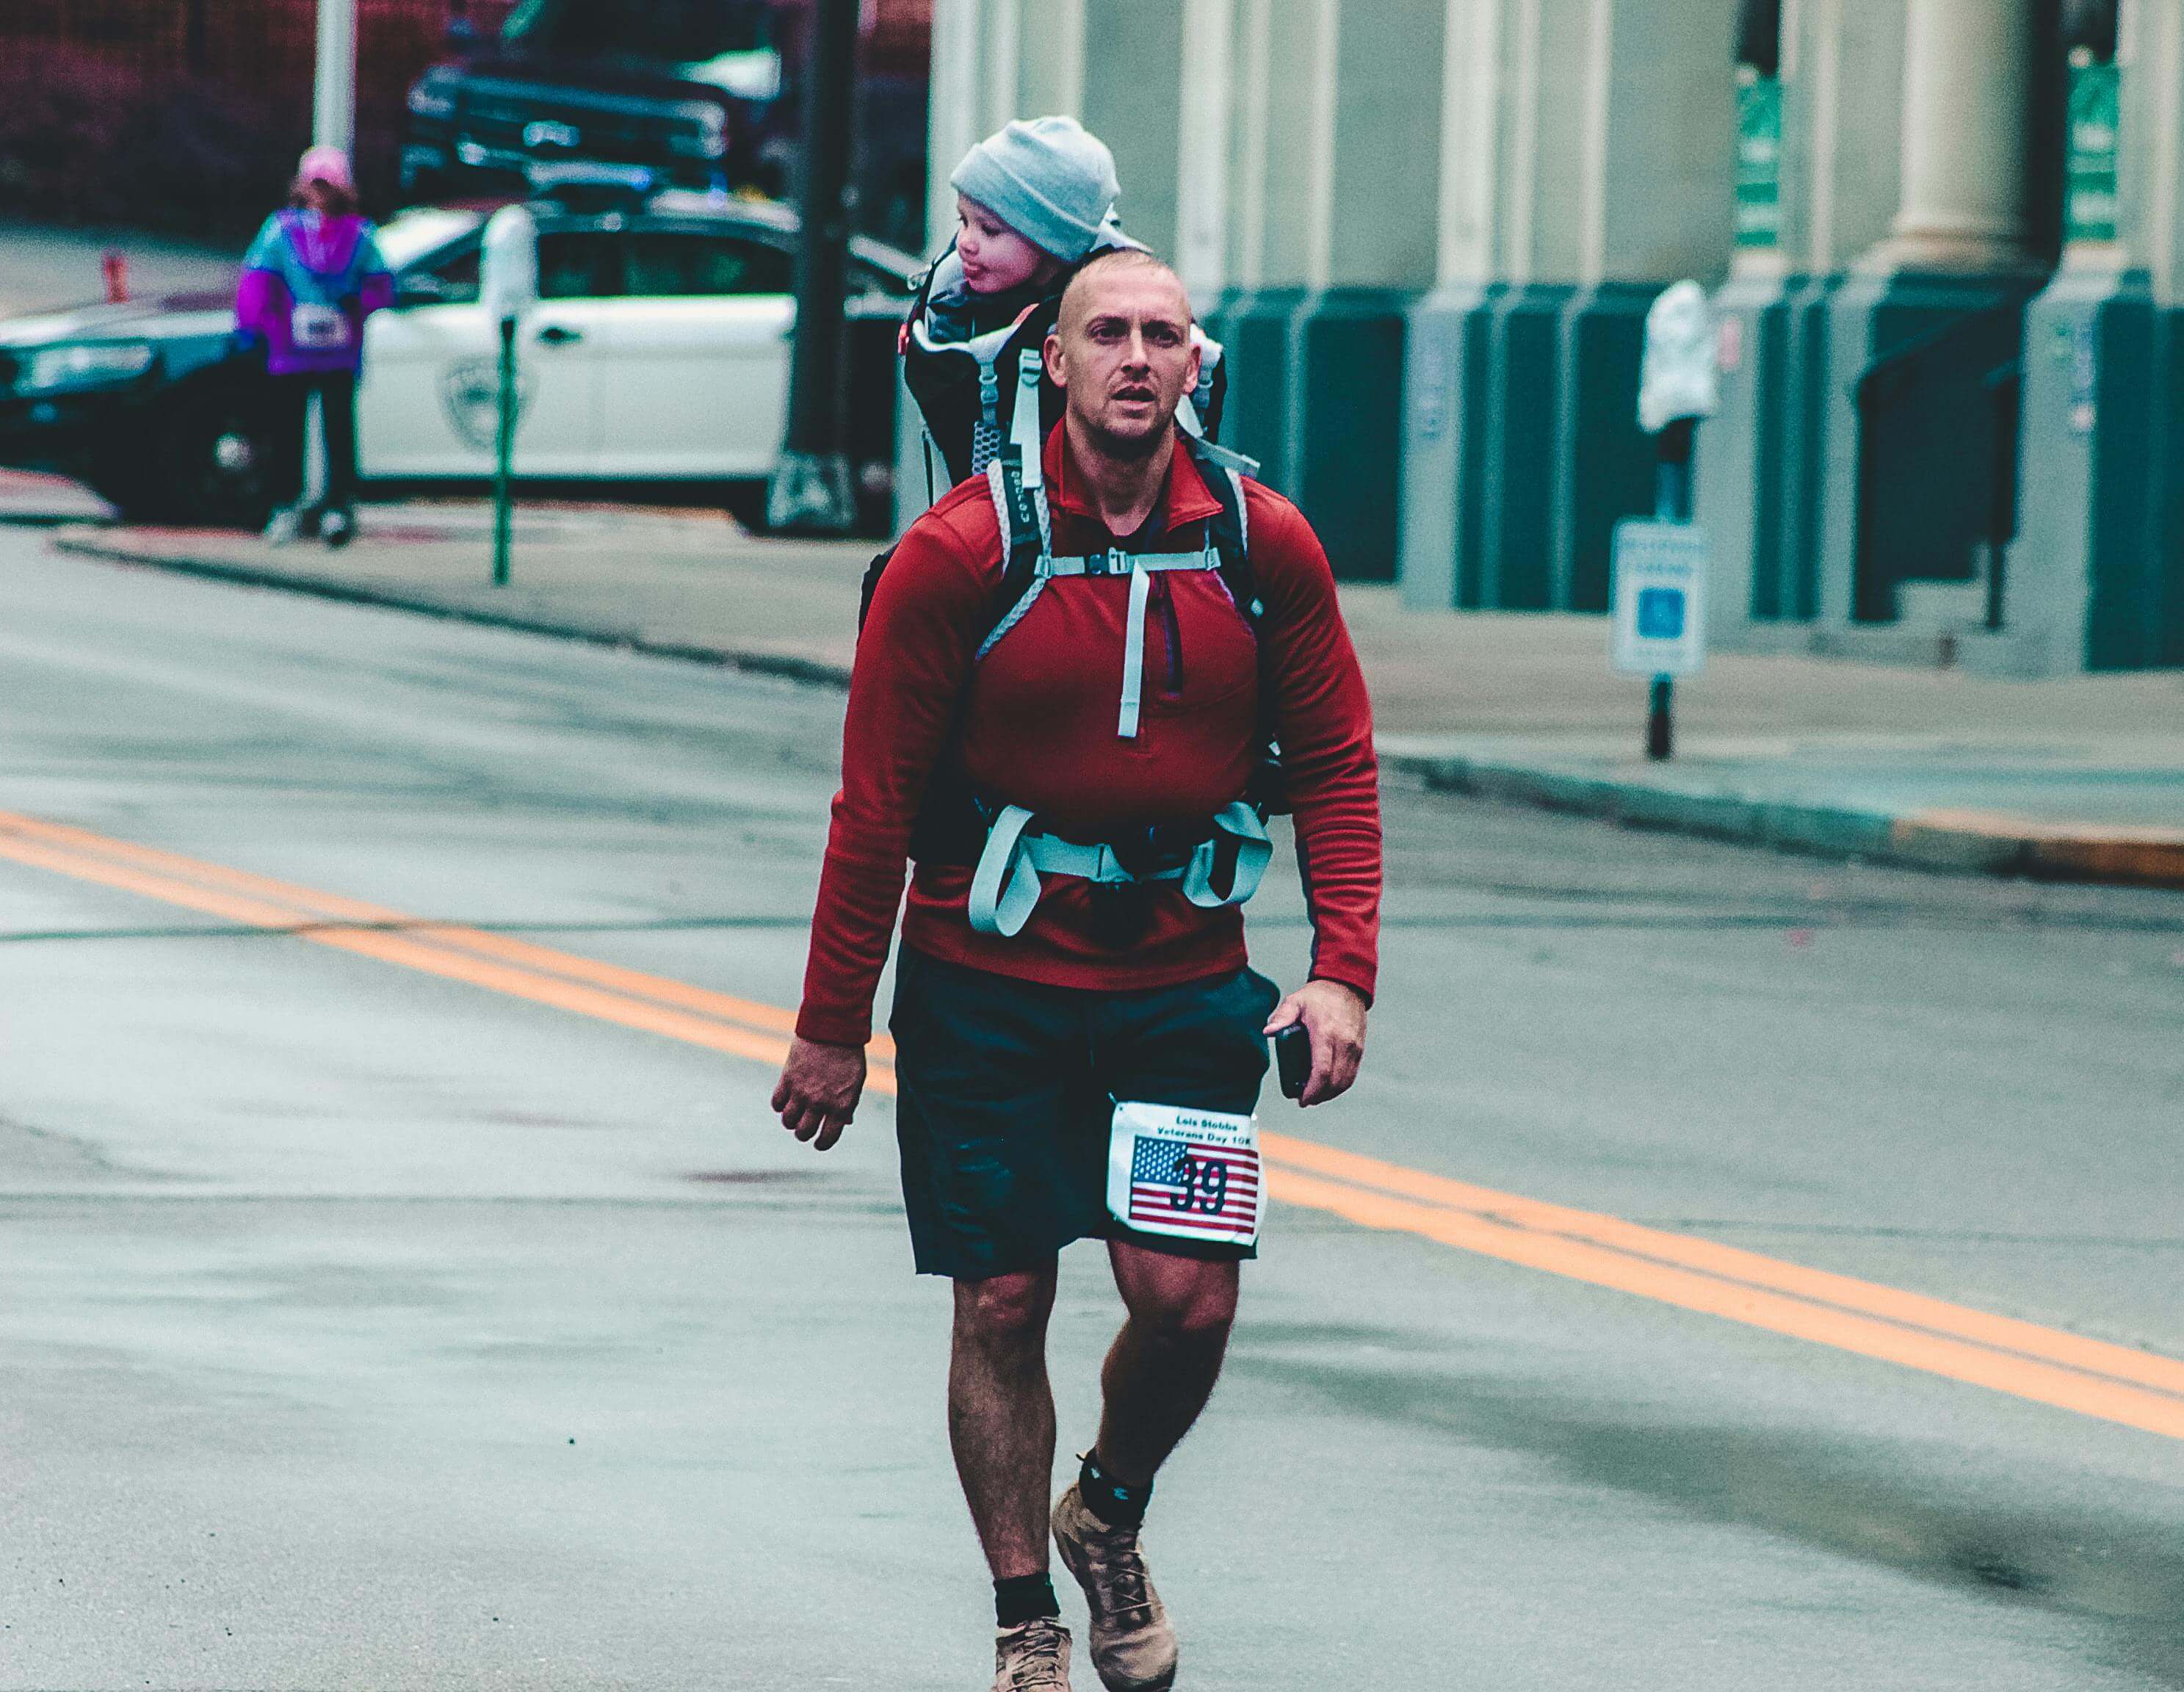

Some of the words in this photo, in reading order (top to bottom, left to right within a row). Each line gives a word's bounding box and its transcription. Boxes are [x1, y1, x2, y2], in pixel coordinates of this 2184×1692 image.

[1176, 1115, 1197, 1126] Lois
[1157, 1127, 1204, 1140] Veterans
[1207, 1133, 1228, 1145] Day
[1170, 1156, 1228, 1215] 39
